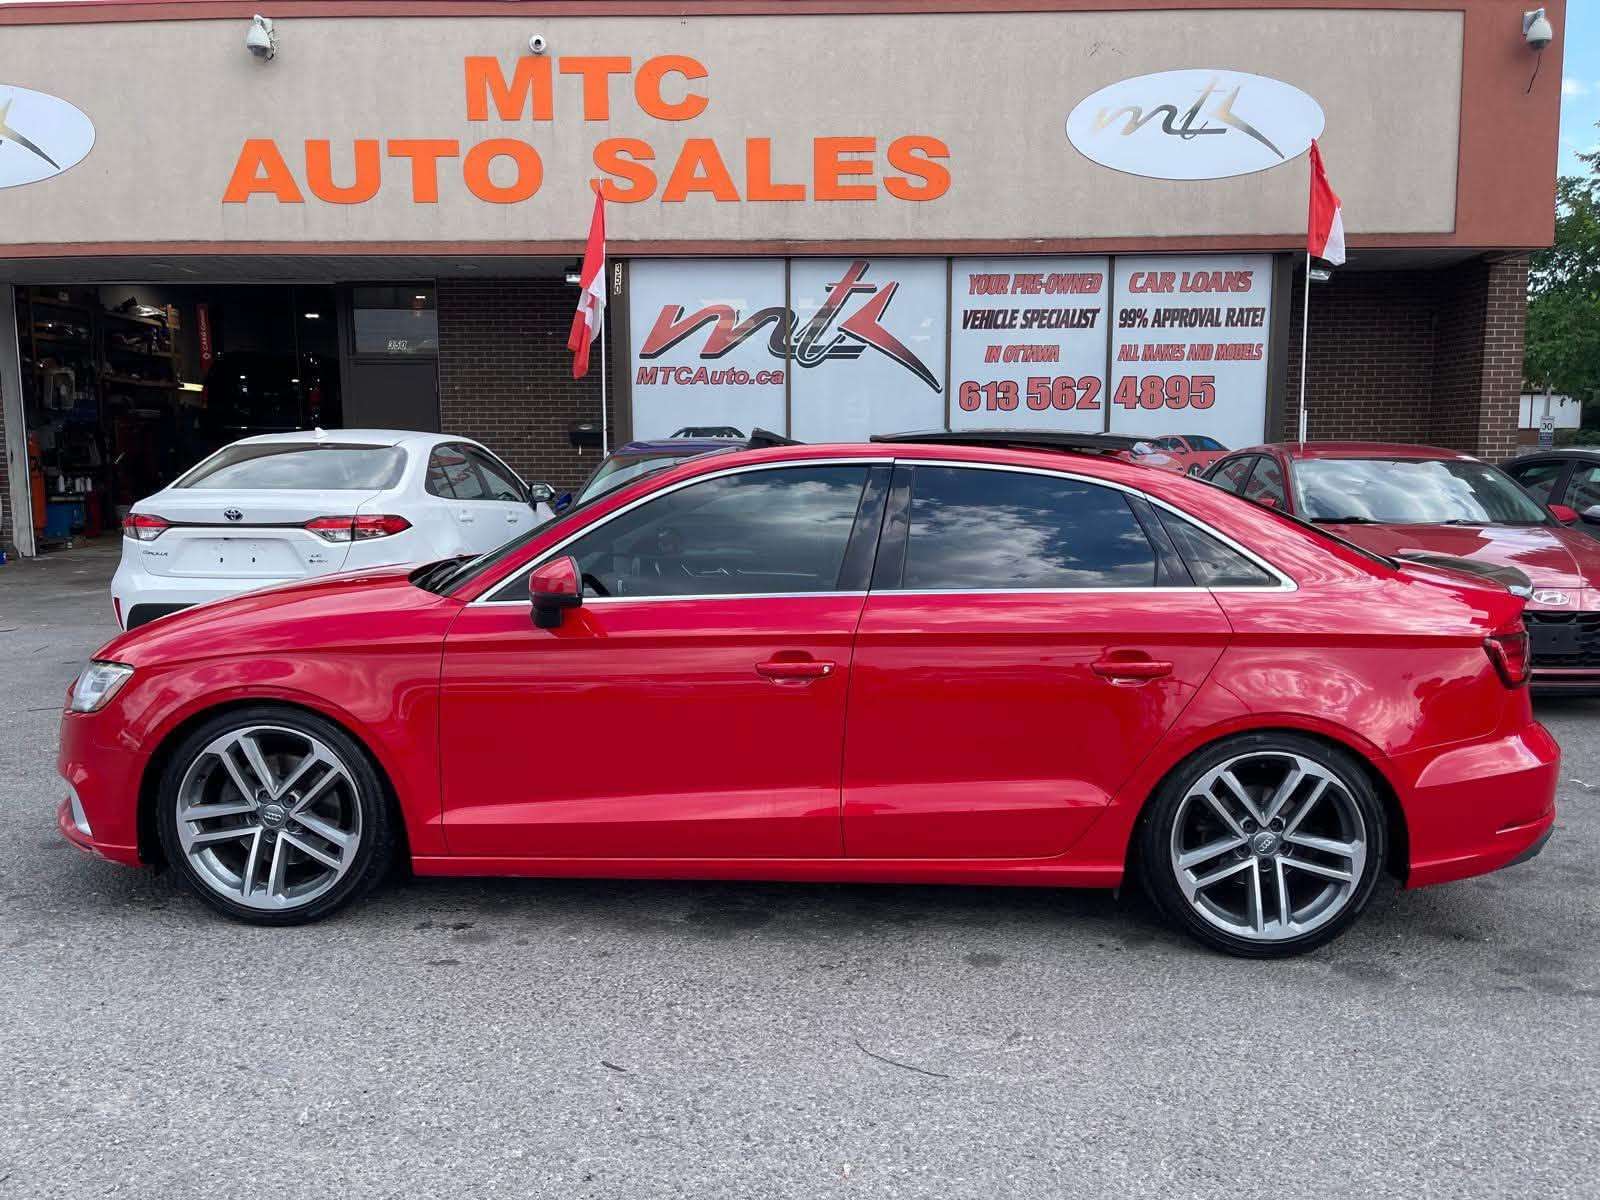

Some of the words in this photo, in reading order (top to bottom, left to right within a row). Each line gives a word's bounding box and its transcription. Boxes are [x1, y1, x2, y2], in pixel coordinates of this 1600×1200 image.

[464, 55, 709, 121] MTC
[222, 138, 544, 204] AUTO
[589, 136, 951, 202] SALES
[969, 274, 1010, 295] YOUR
[1011, 273, 1103, 295] PRE-OWNED
[1129, 271, 1176, 293] CAR
[1179, 271, 1253, 293] LOANS
[962, 309, 1019, 329] VEHICLE
[1020, 308, 1100, 329] SPECIALIST
[1119, 308, 1149, 328] 99%
[1151, 307, 1222, 328] APPROVAL
[1224, 307, 1266, 328] RATE!
[984, 345, 1001, 363] IN
[1003, 345, 1060, 363] OTTAWA
[1117, 344, 1140, 362] ALL
[1141, 344, 1186, 362] MAKES
[1186, 344, 1214, 362] AND
[1214, 343, 1264, 361] MODELS
[636, 366, 784, 385] MTCAuto.ca
[959, 380, 1019, 411] 613
[1026, 376, 1101, 410] 562
[1114, 375, 1215, 409] 4895
